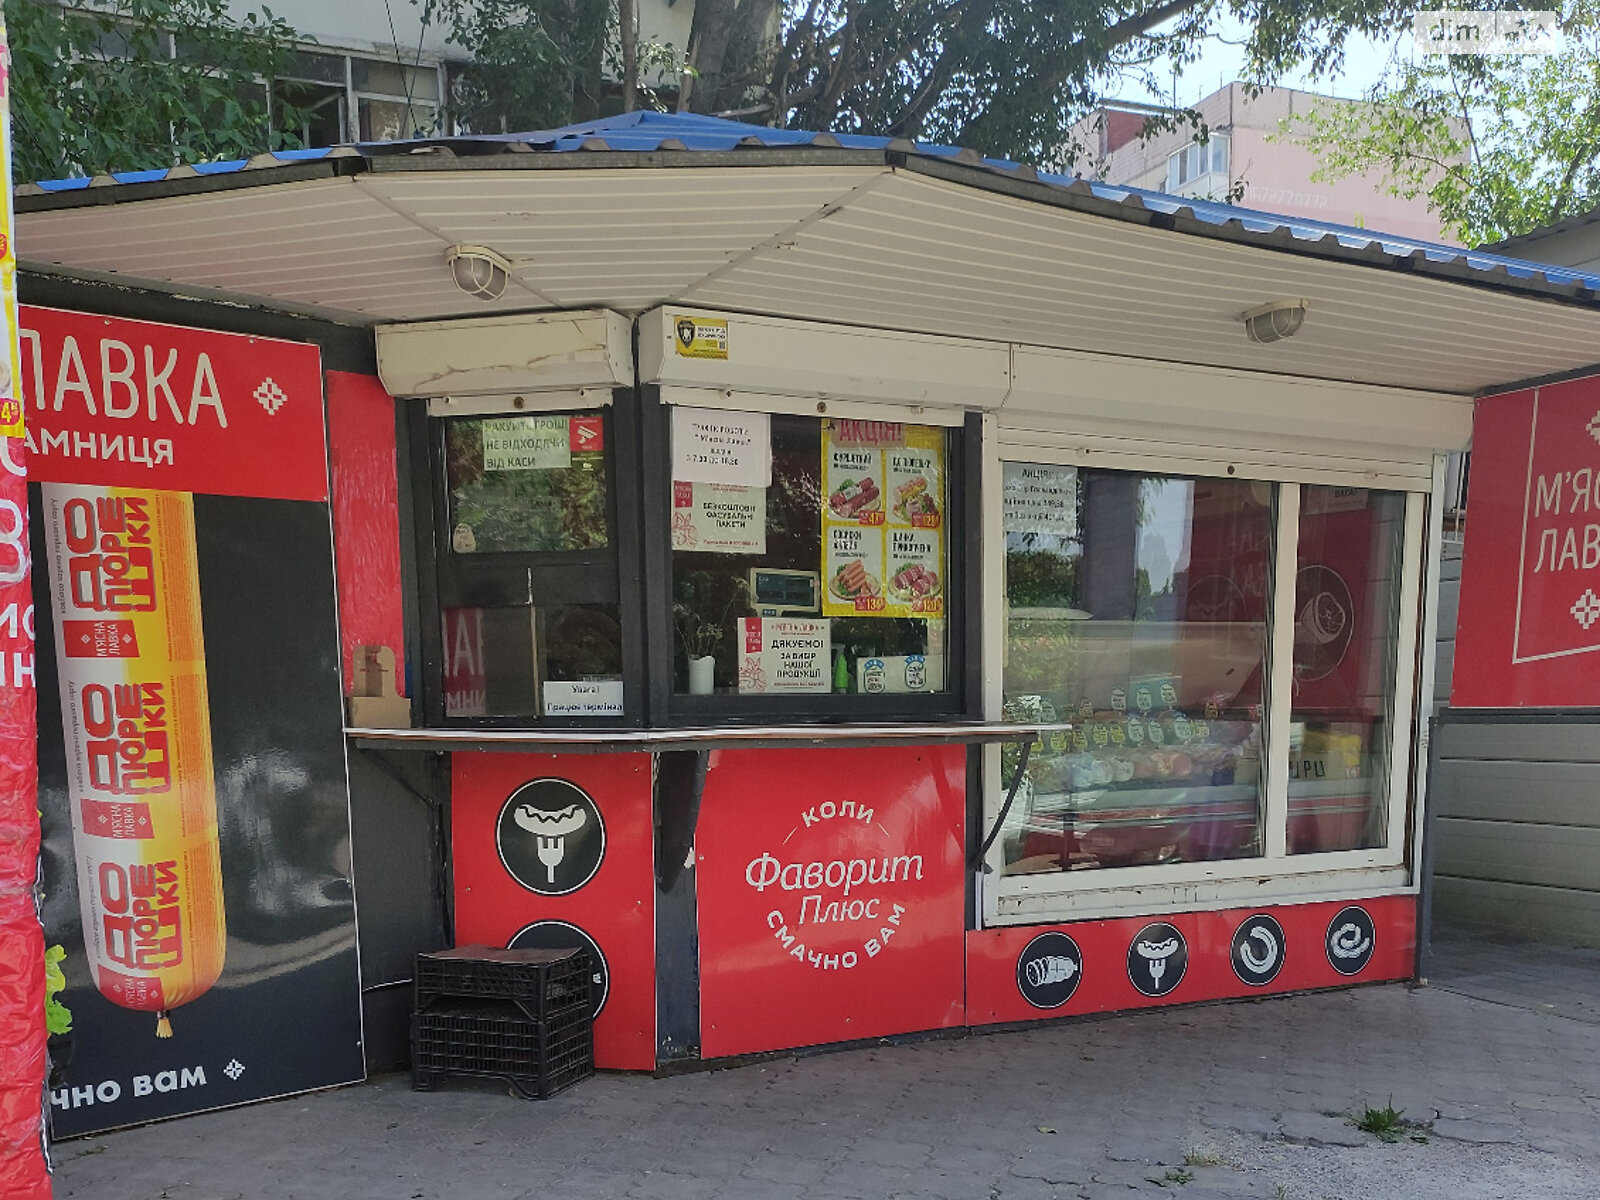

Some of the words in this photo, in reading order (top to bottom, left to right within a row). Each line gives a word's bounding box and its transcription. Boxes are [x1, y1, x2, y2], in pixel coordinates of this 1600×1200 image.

[487, 440, 500, 450] НЕ
[487, 459, 505, 470] ВІД
[507, 457, 536, 467] КАСИ
[63, 498, 104, 612] ДО
[81, 683, 121, 796] ДО
[801, 800, 874, 828] КОЛИ
[745, 852, 923, 896] Фаворит
[98, 862, 136, 969] ДО
[799, 895, 880, 924] Плюс
[767, 910, 858, 970] СМАЧНО
[864, 903, 906, 957] ВАМ
[133, 1064, 207, 1098] вам
